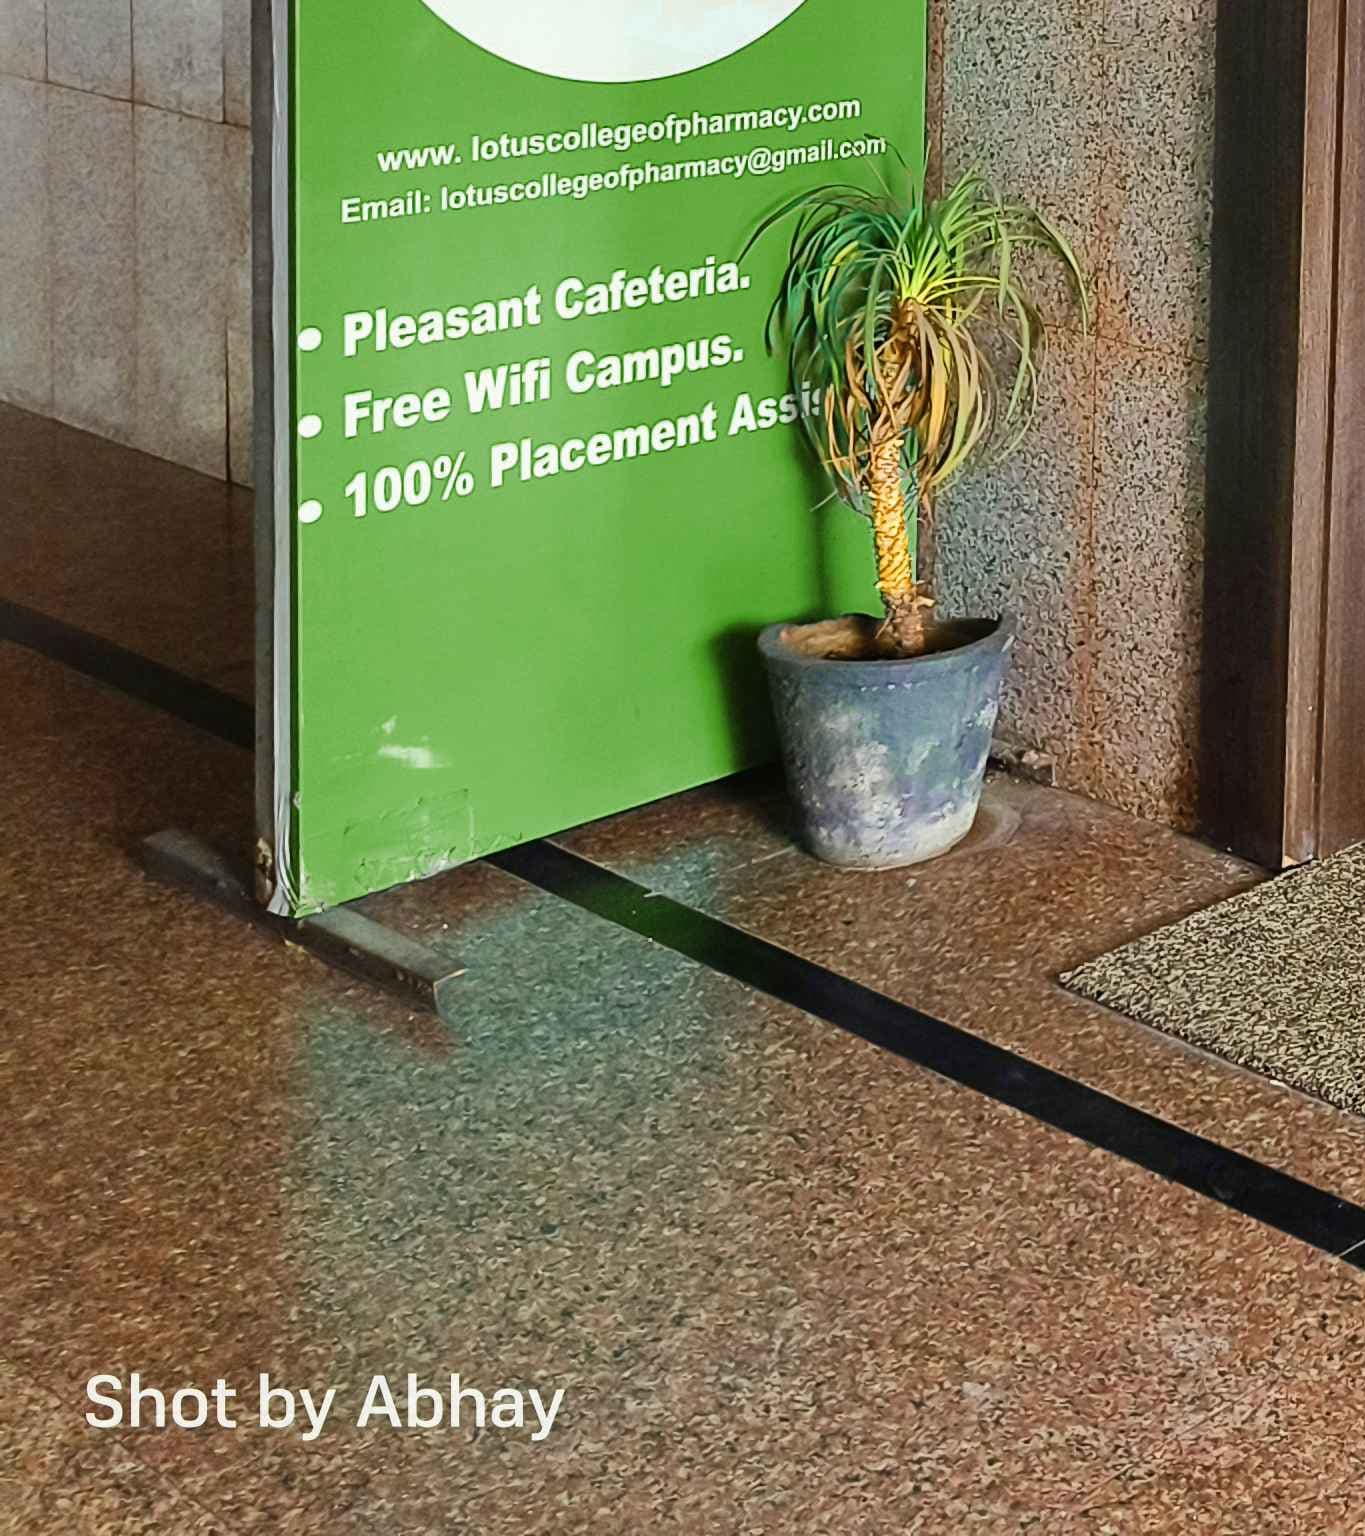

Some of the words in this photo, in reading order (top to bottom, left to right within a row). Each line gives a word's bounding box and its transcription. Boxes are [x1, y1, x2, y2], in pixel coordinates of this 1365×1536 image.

[341, 190, 431, 224] Email:
[441, 136, 886, 211] lotuscollegeofpharmacy@gmail.com
[377, 144, 462, 172] www.
[471, 98, 861, 162] lotuscollegeofpharmacy.com
[343, 284, 541, 357] Pleasant
[555, 256, 751, 320] Cafeteria.
[344, 386, 451, 438] Free
[464, 356, 551, 413] Wifi
[565, 334, 744, 394] Campus.
[344, 451, 475, 518] 100%
[490, 400, 718, 488] Placement
